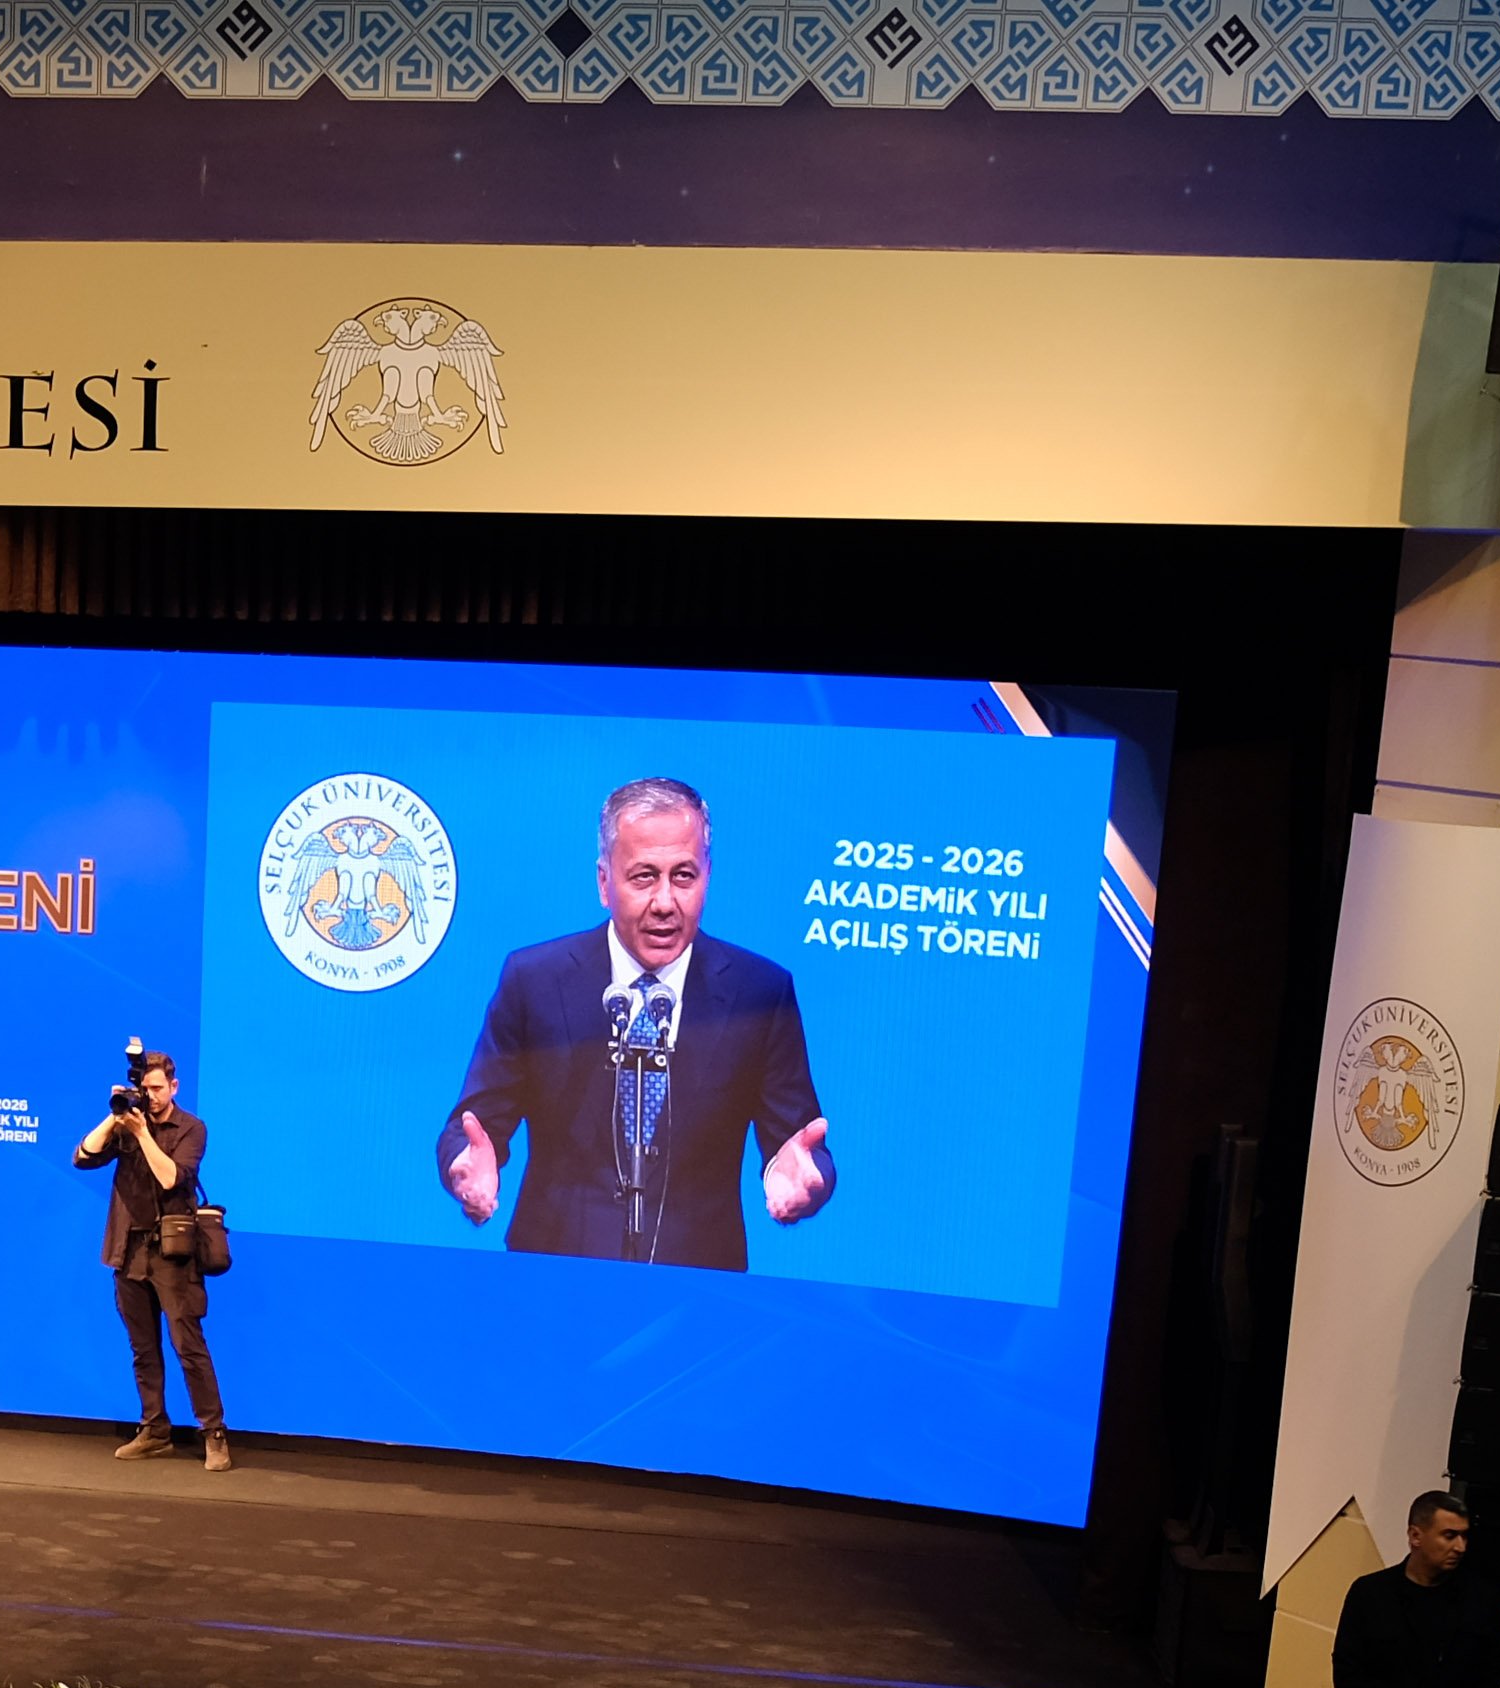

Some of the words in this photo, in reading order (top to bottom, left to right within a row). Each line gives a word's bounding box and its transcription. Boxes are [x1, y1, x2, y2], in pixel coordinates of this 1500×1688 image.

[265, 796, 320, 894] SELÇUK
[833, 839, 915, 870] 2025
[941, 846, 1024, 877] 2026
[803, 879, 978, 916] AKADEMİK
[987, 890, 1047, 920] YILI
[803, 918, 908, 956] AÇILIŞ
[916, 920, 1040, 960] TÖRENİ
[305, 950, 359, 980] KONYA
[374, 955, 406, 978] 1908
[13, 1115, 39, 1128] YILI
[1353, 1146, 1387, 1176] KONYA
[1397, 1158, 1421, 1175] 1908
